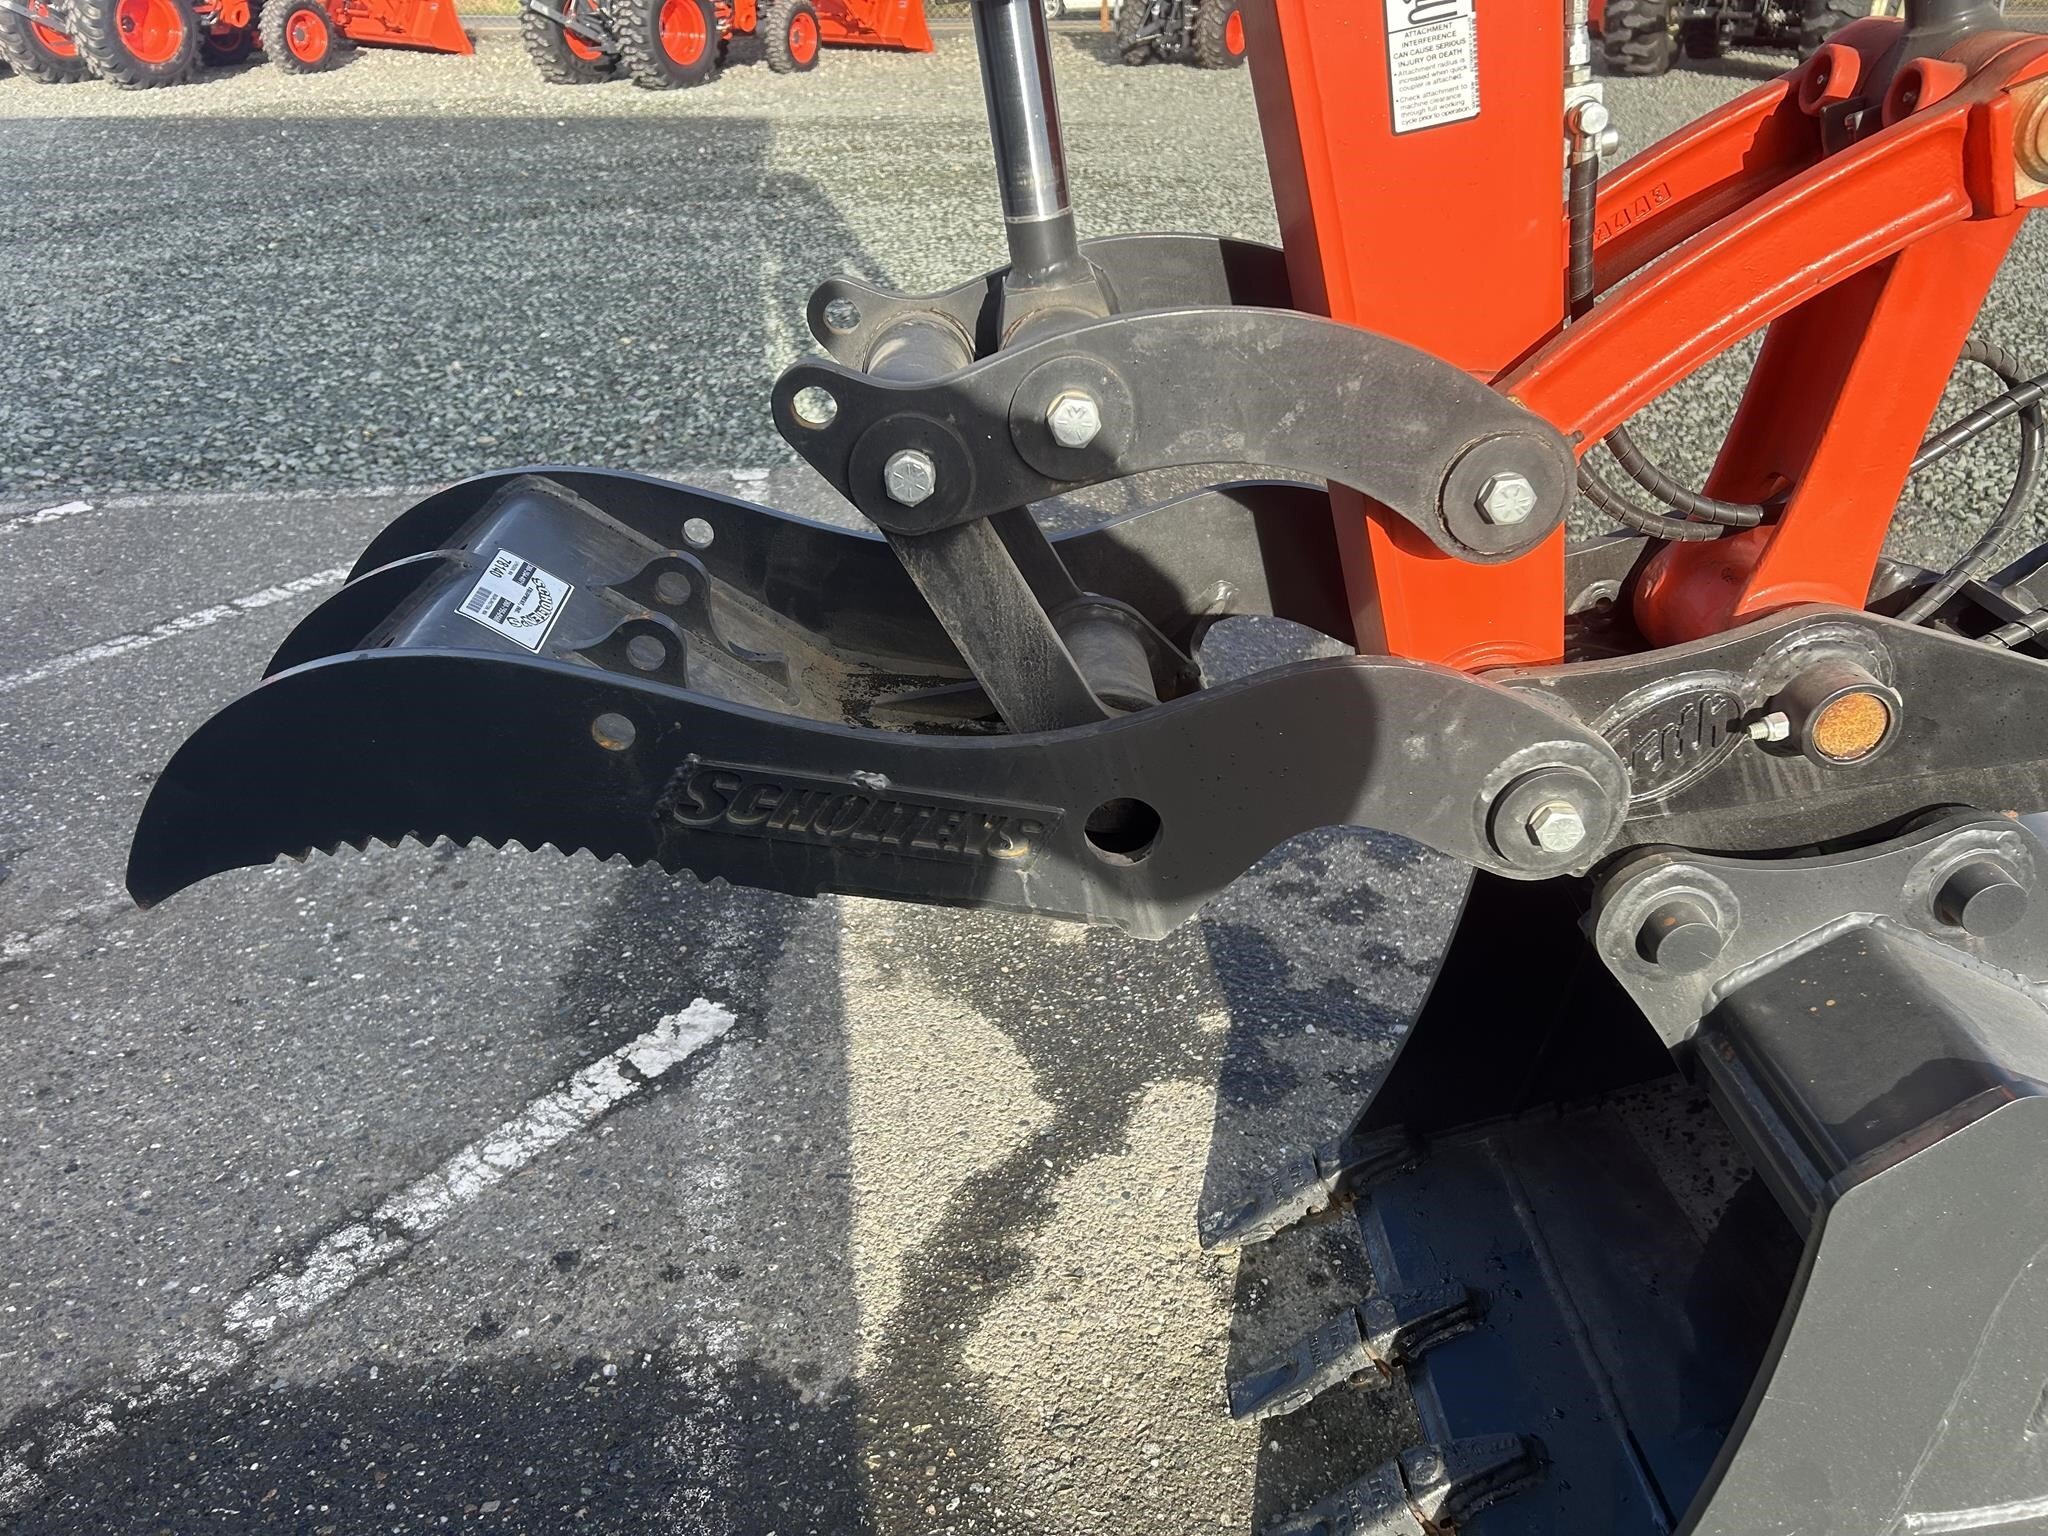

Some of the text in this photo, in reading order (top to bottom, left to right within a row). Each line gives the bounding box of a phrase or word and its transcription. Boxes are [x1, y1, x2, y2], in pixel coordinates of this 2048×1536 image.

[1402, 31, 1457, 48] INTERFERENCE
[1404, 22, 1452, 38] ATTACHMENT
[1393, 38, 1466, 60] CAN CAUSE SERIOUS
[1398, 48, 1462, 68] INJURY OR DEATH
[1398, 63, 1436, 77] Attachment
[1438, 59, 1458, 68] radius
[1398, 65, 1467, 85] increased when quick
[1400, 95, 1420, 103] Check
[1422, 86, 1459, 98] attachment
[1400, 101, 1428, 111] machine
[1401, 100, 1465, 119] through full working
[1401, 117, 1417, 126] cycle
[1419, 113, 1433, 122] prior
[489, 556, 512, 579] 78140
[506, 577, 553, 628] SCHOLTEN'S
[673, 768, 1043, 860] SCHOLTEN'S
